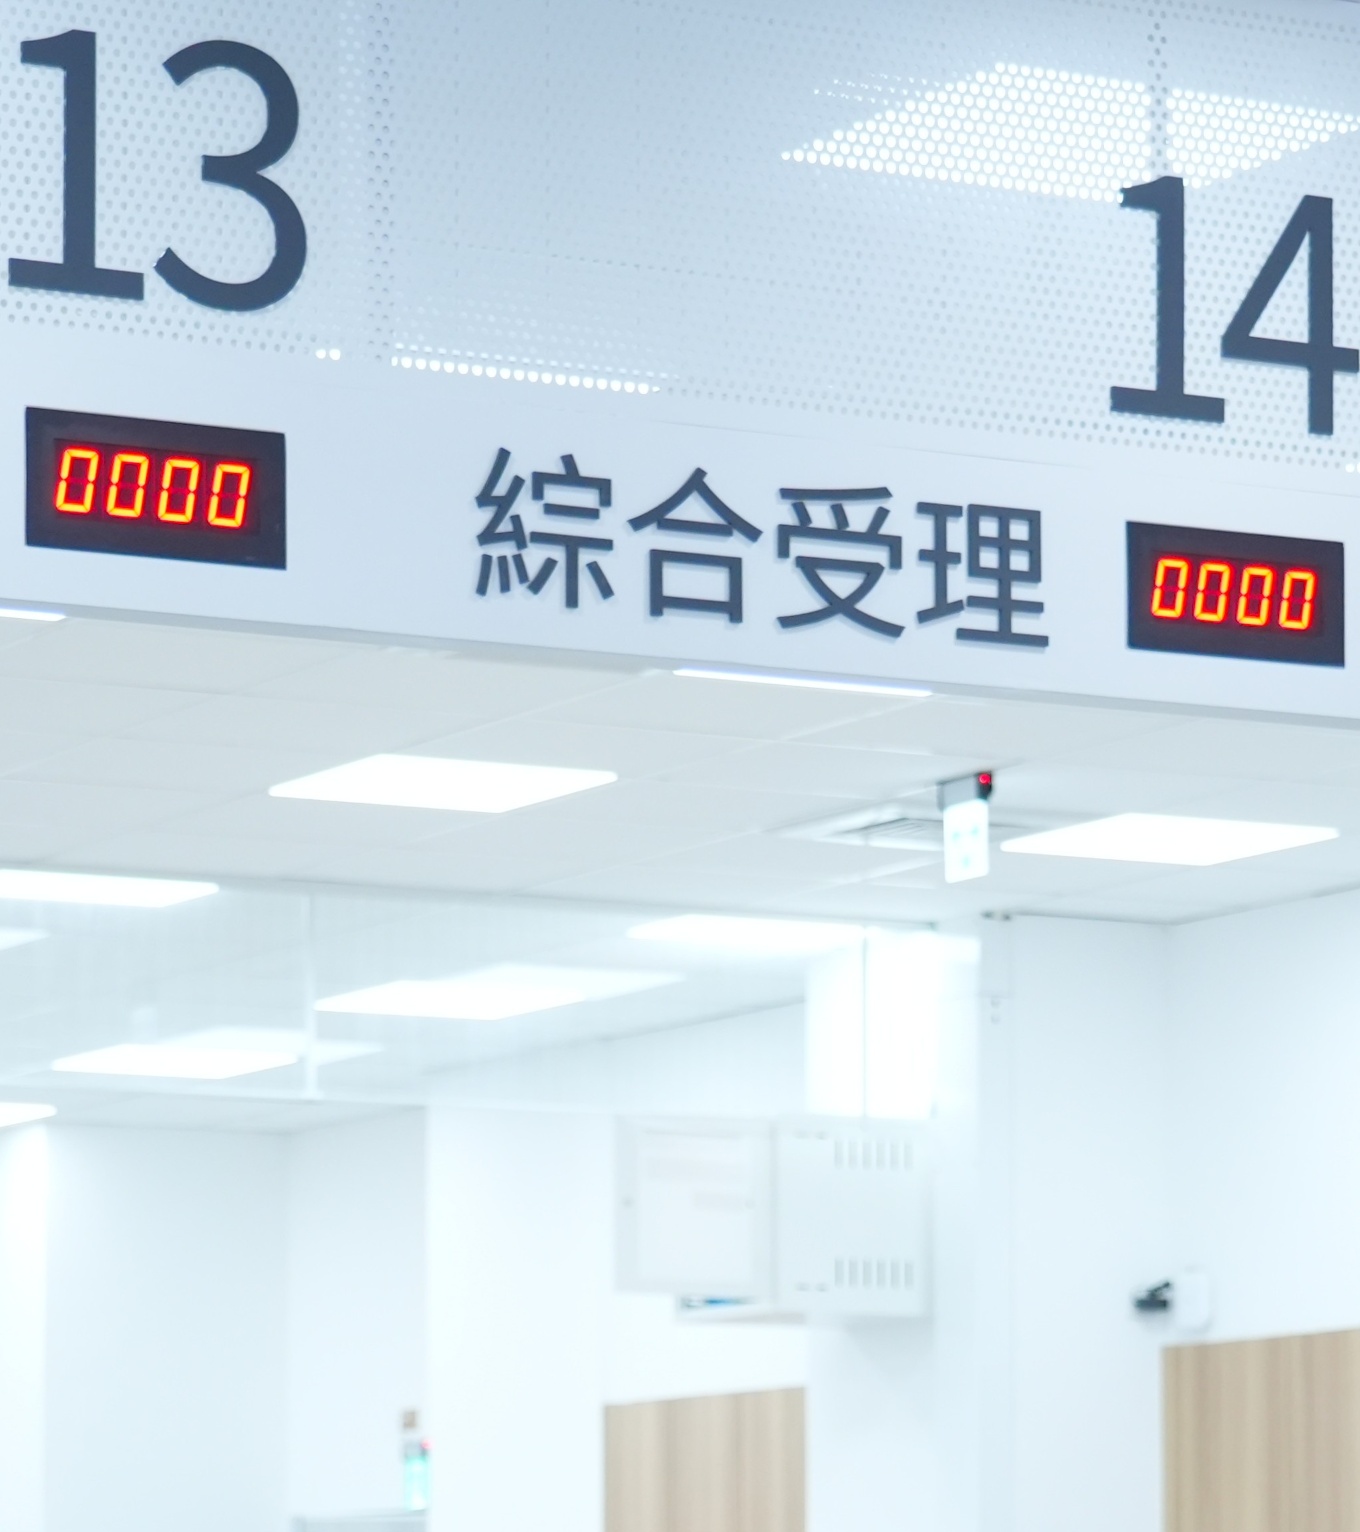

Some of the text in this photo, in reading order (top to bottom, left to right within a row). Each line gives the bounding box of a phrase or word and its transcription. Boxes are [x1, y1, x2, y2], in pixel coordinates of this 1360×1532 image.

[8, 29, 307, 312] 13
[1110, 175, 1360, 436] 14
[53, 446, 252, 529] 0000
[475, 447, 1049, 649] 綜合受理
[1150, 556, 1318, 631] 0000
